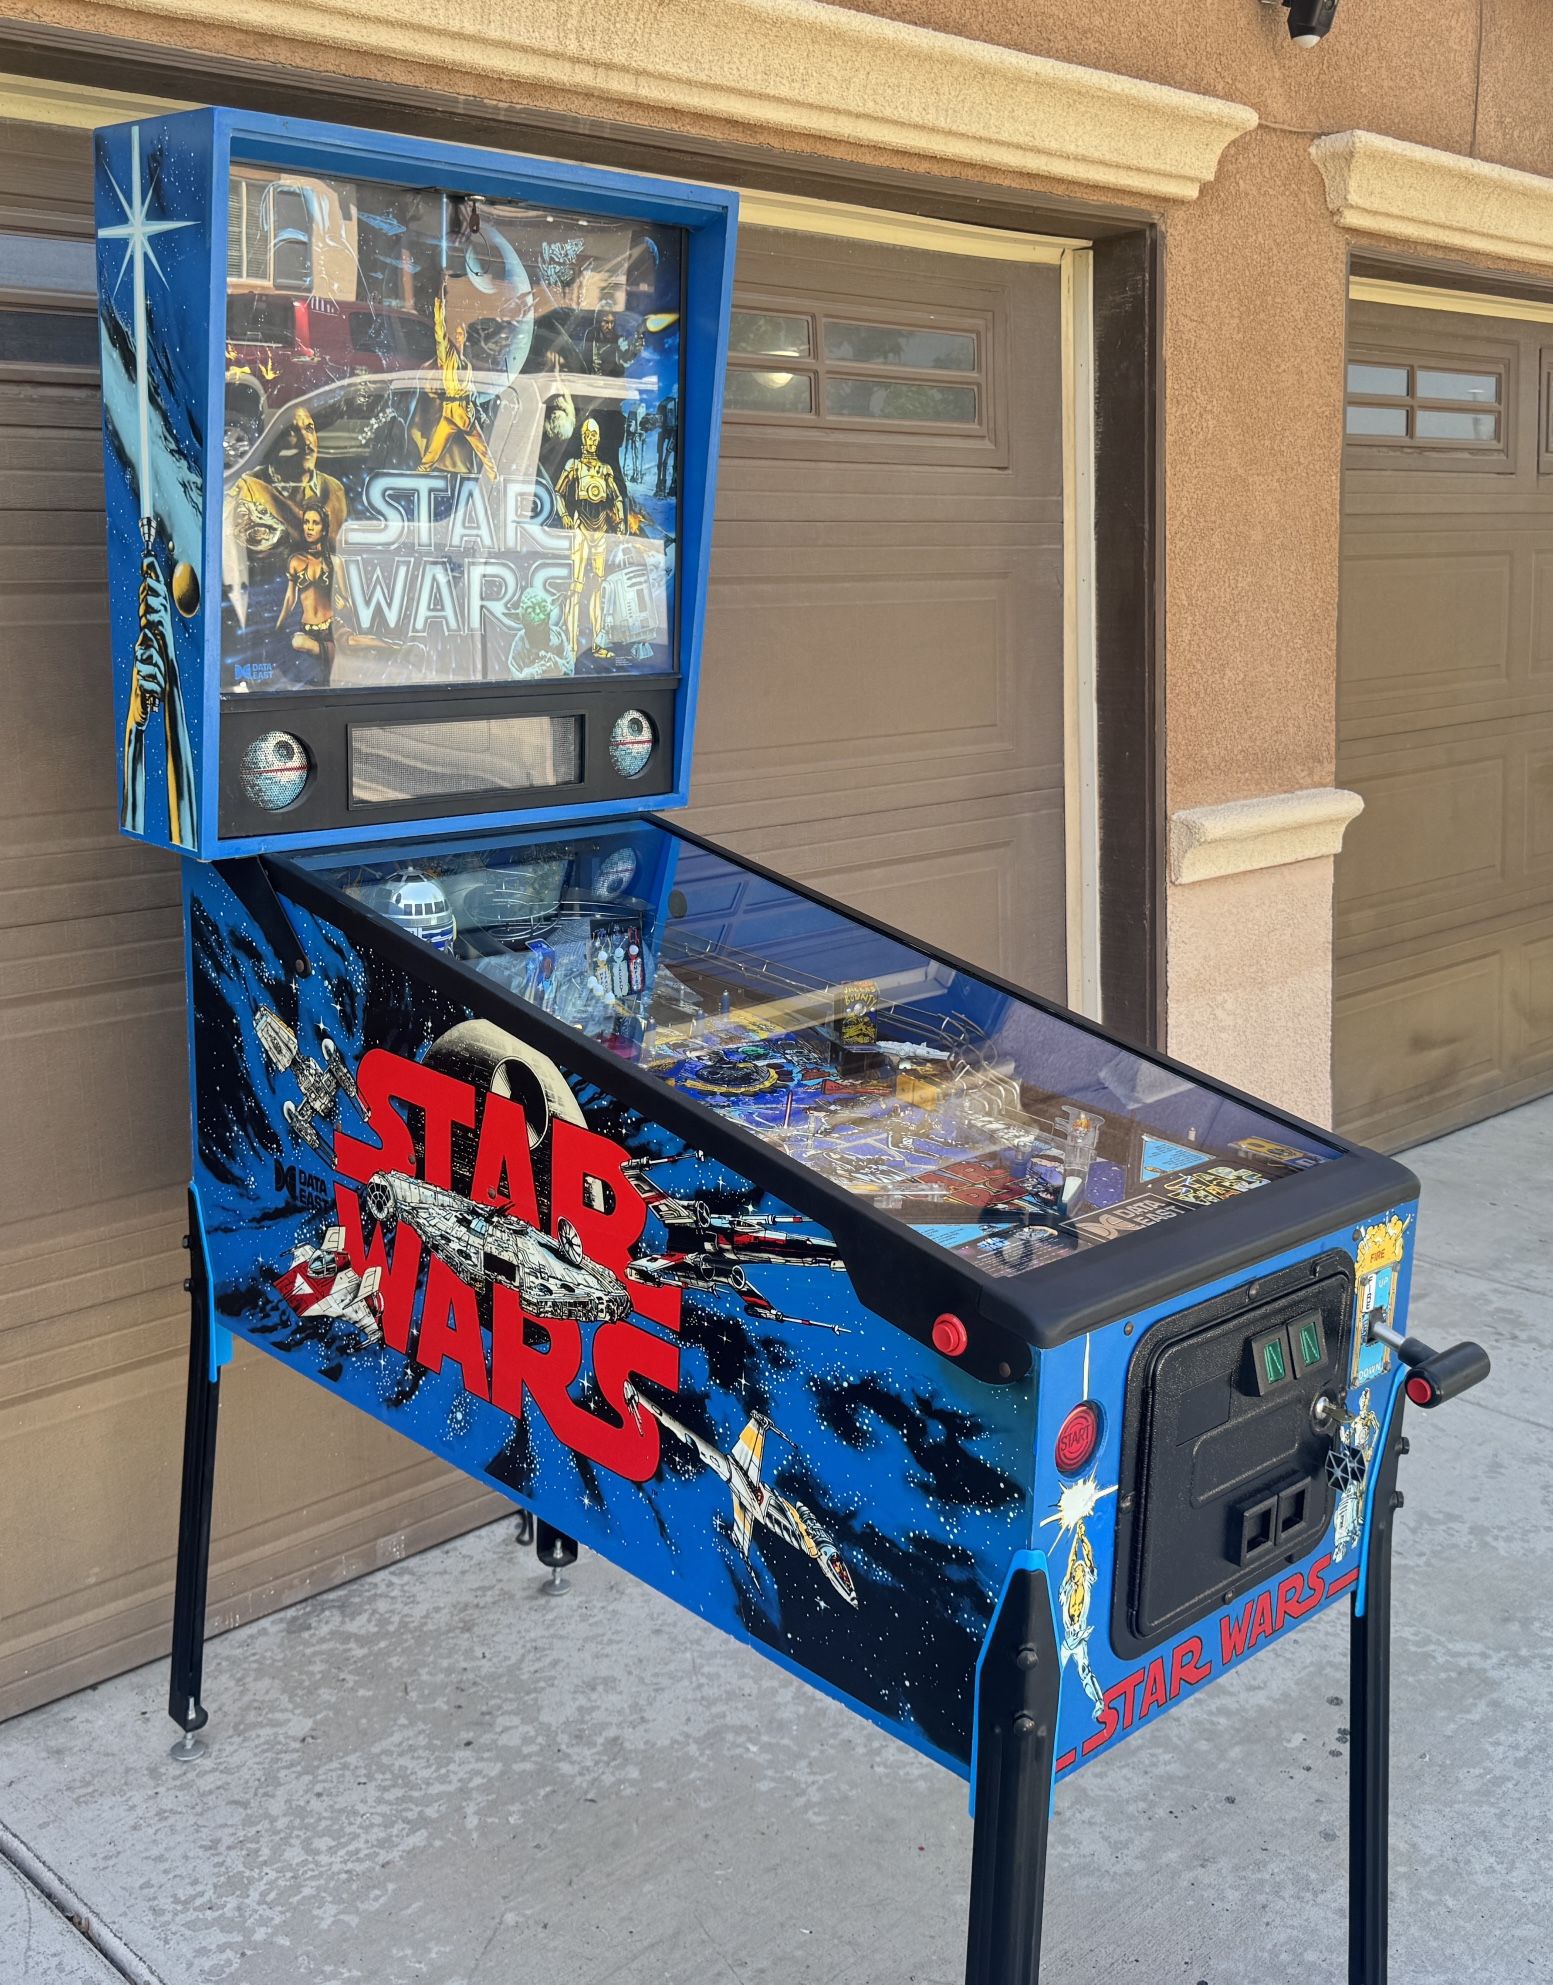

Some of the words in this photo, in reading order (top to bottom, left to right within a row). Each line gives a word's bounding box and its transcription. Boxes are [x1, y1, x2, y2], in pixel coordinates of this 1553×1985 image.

[342, 469, 574, 554] STAR
[342, 557, 574, 636] WARS
[252, 663, 273, 671] DATA
[252, 671, 273, 680] EAST
[299, 1169, 327, 1196] DATA
[334, 1047, 682, 1333] STAR
[1112, 1200, 1166, 1218] DATA
[1133, 1205, 1185, 1227] EAST
[1370, 1249, 1386, 1262] FIRE
[1379, 1277, 1388, 1287] UP
[333, 1181, 680, 1482] WARS
[1359, 1362, 1381, 1379] DOWN
[1061, 1423, 1091, 1451] START
[1082, 1635, 1212, 1756] STAR
[1220, 1554, 1332, 1665] WARS
